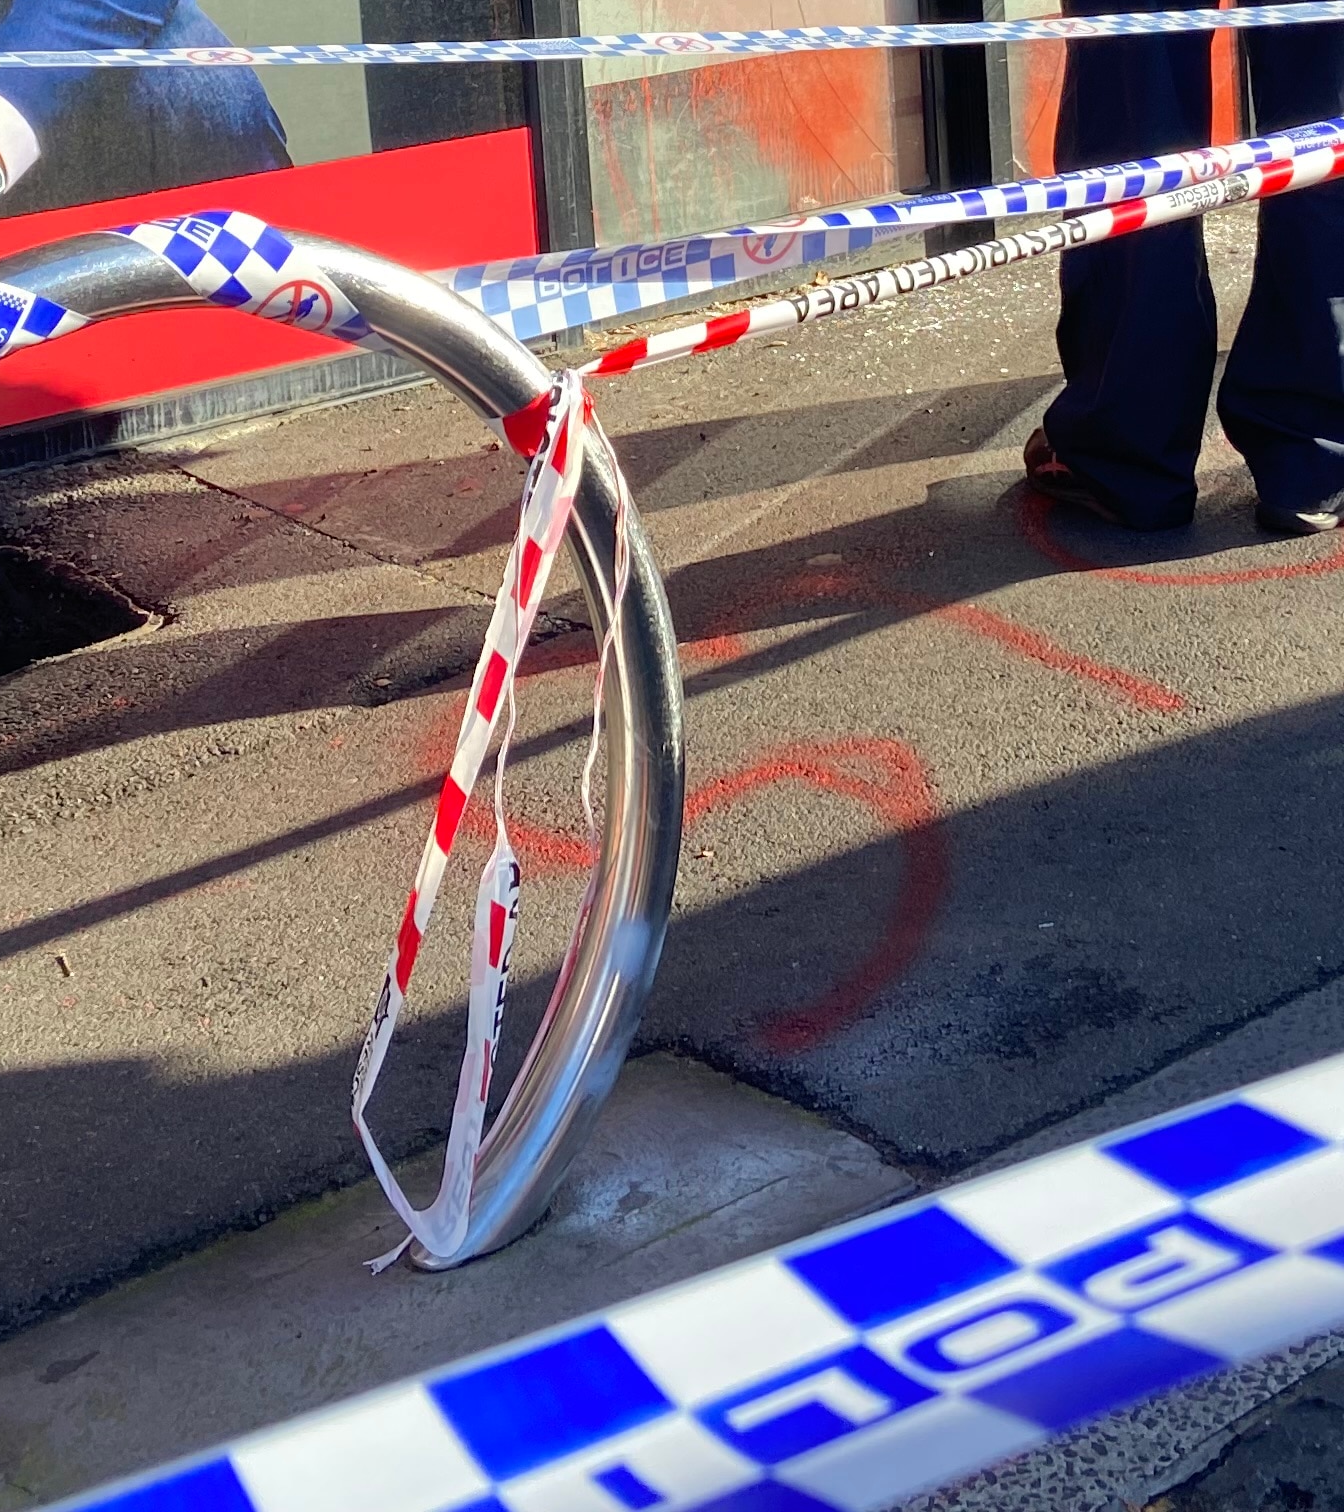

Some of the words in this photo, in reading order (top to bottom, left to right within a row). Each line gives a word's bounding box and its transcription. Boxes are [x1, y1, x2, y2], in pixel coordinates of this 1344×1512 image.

[1166, 182, 1219, 209] RESCUE
[893, 215, 1088, 295] RESTRICTED
[787, 274, 881, 323] AREA
